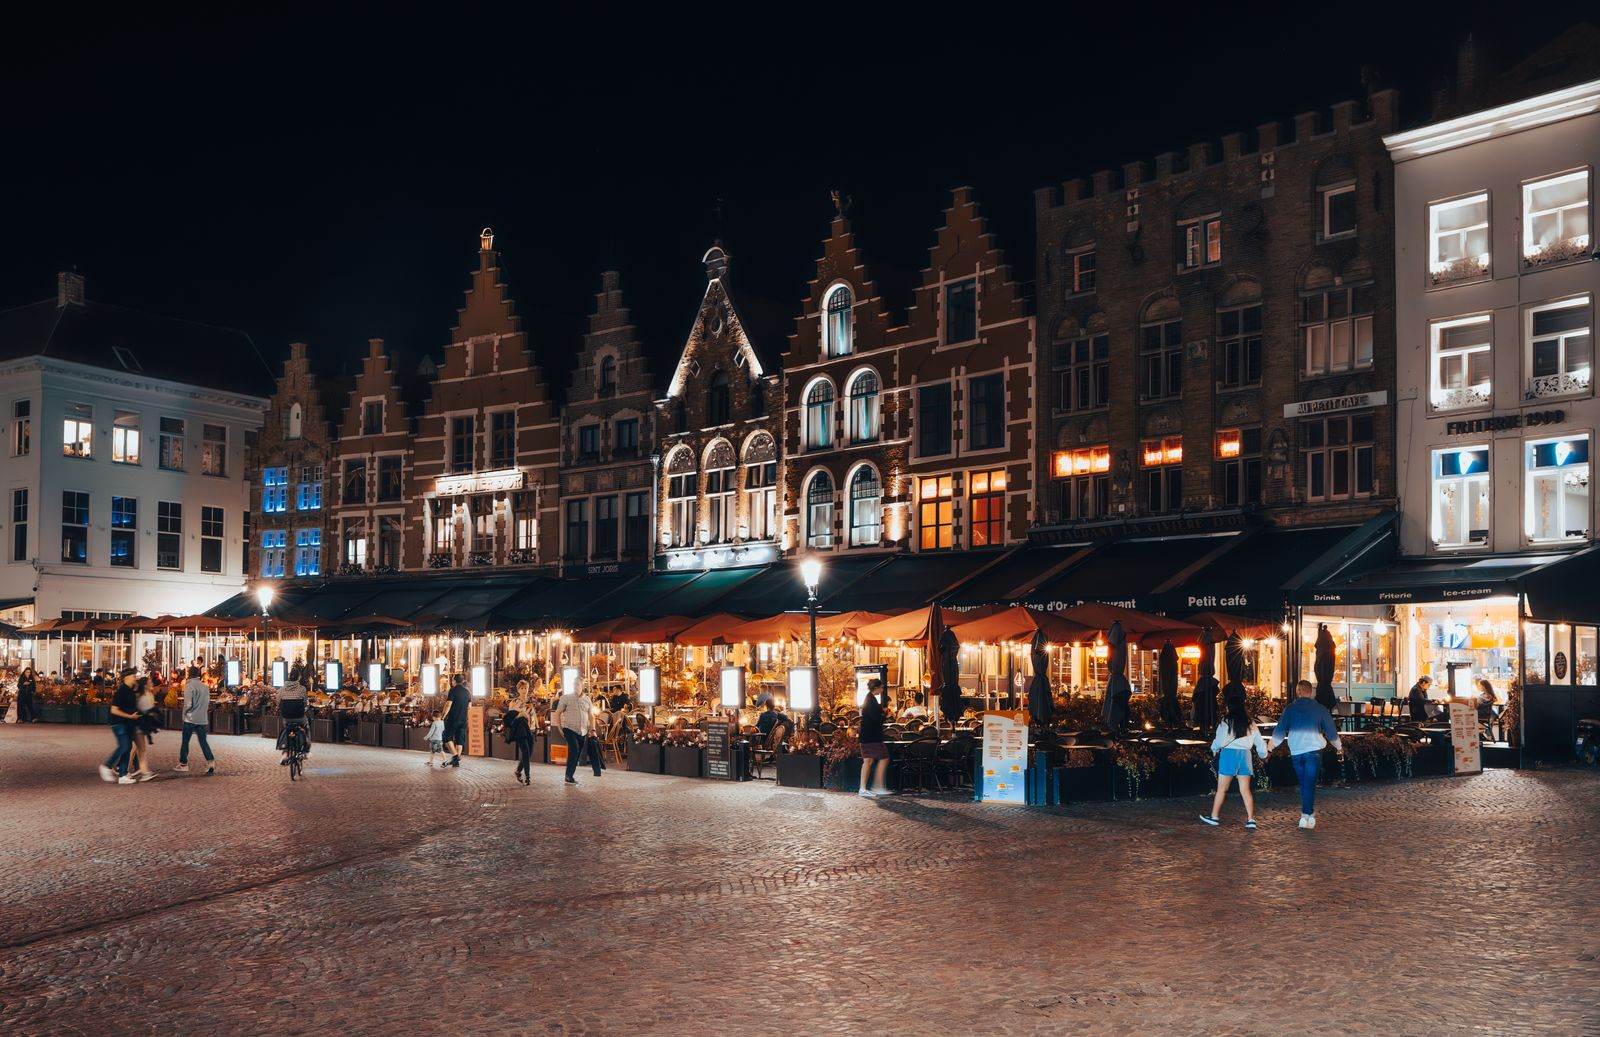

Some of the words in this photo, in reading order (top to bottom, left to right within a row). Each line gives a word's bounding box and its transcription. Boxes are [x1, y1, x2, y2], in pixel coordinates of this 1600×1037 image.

[1297, 403, 1308, 415] AU
[1447, 415, 1521, 435] FRITERIE
[1379, 592, 1412, 600] Friterie
[1443, 588, 1492, 597] Ice-cream
[1188, 596, 1216, 607] Petit
[1220, 594, 1247, 606] café
